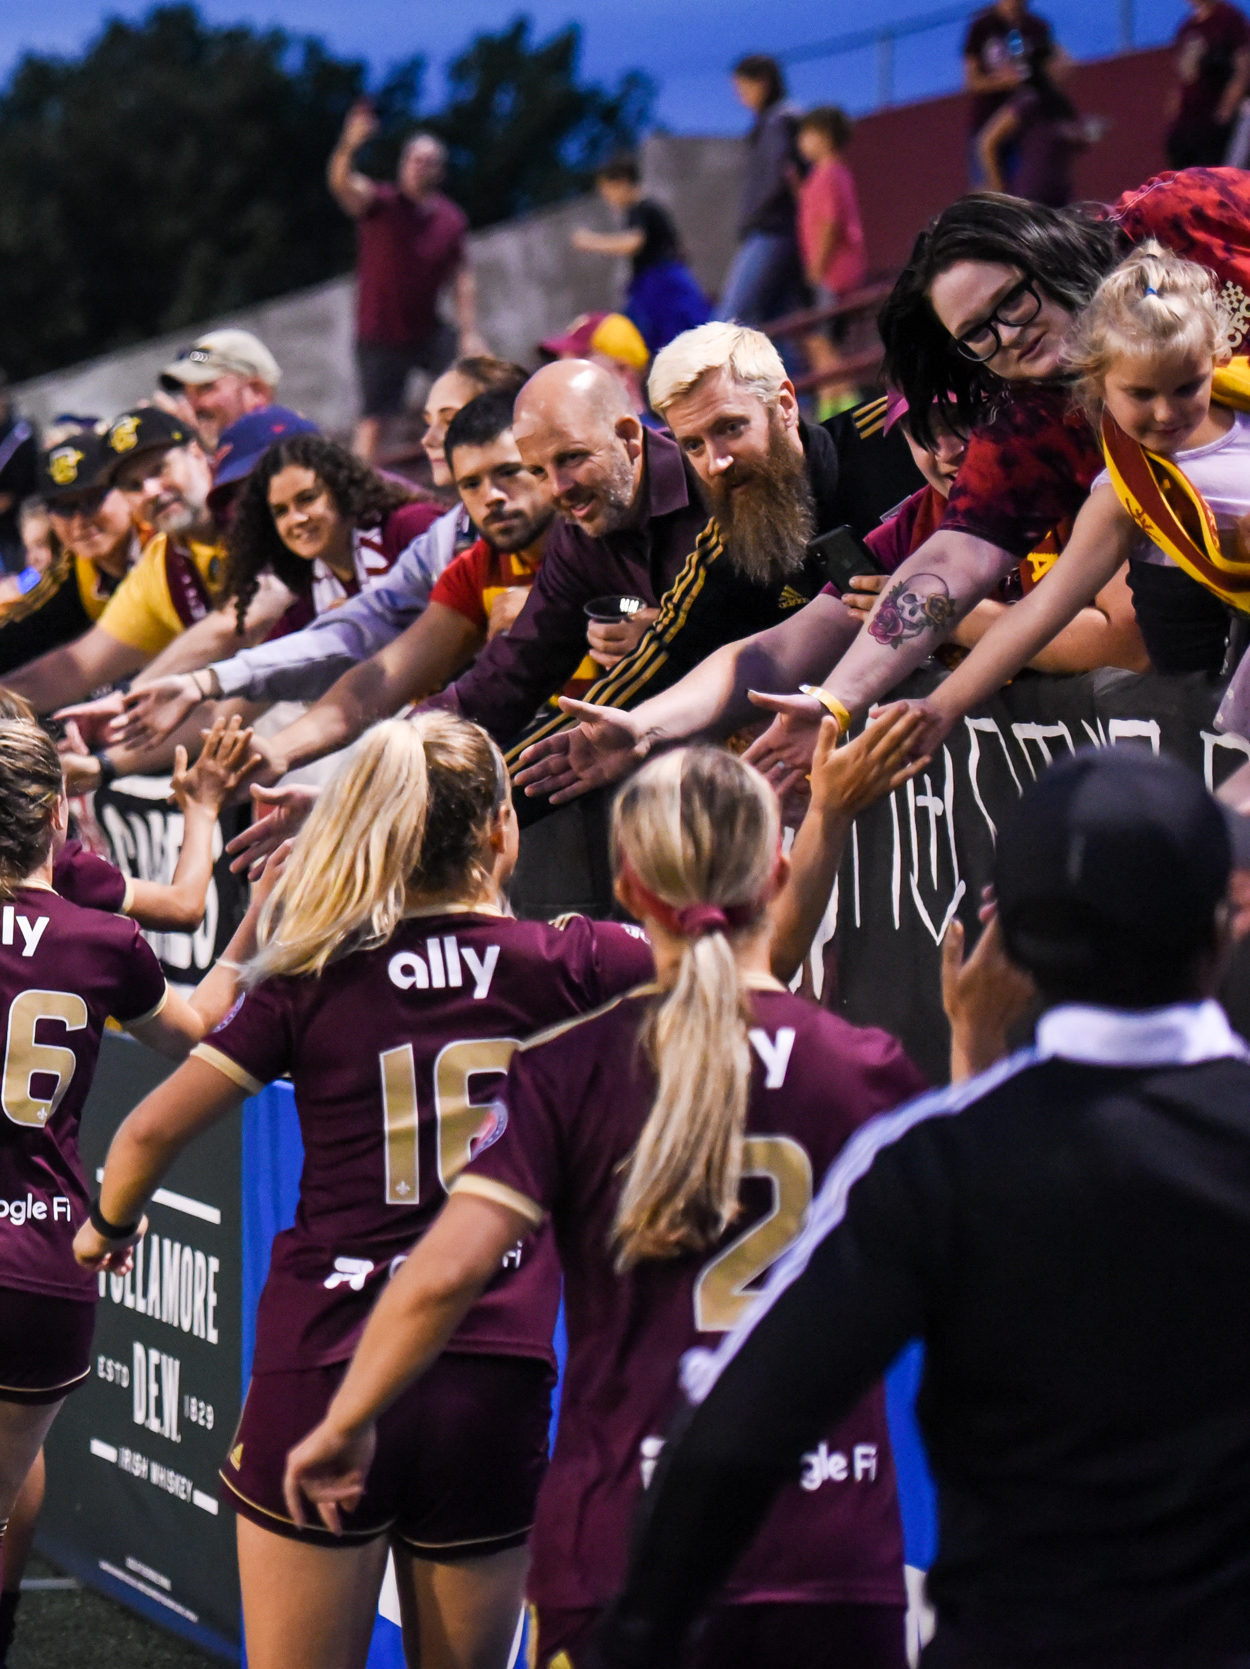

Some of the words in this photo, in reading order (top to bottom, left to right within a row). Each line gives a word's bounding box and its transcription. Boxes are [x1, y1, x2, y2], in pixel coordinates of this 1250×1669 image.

[388, 936, 500, 999] ally
[379, 1036, 525, 1205] 16
[52, 1196, 72, 1223] Fi
[693, 1135, 814, 1332] 2
[183, 1394, 215, 1430] 1829
[853, 1443, 878, 1483] Fi
